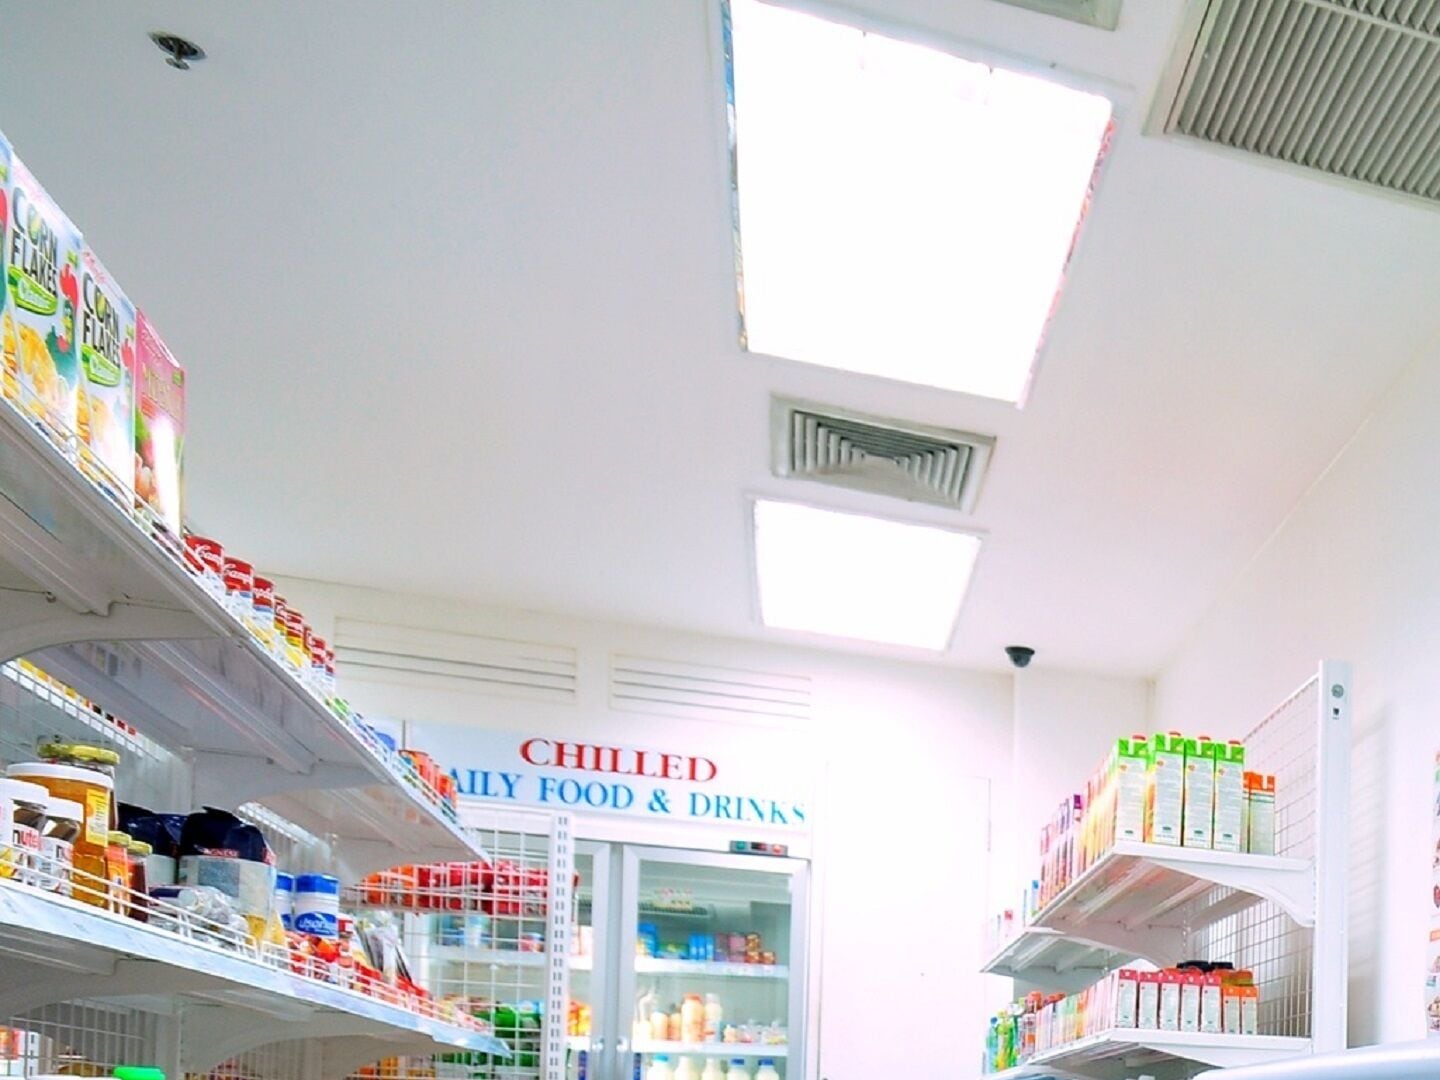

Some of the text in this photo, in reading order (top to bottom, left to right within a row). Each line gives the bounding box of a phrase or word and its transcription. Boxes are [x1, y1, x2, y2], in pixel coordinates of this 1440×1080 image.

[12, 187, 58, 260] CORN
[11, 228, 58, 299] FLAKES
[82, 272, 120, 338] CORN
[82, 309, 121, 370] FLAKES
[519, 737, 718, 783] CHILLED
[448, 766, 807, 826] AILY FOOD & DRINKS
